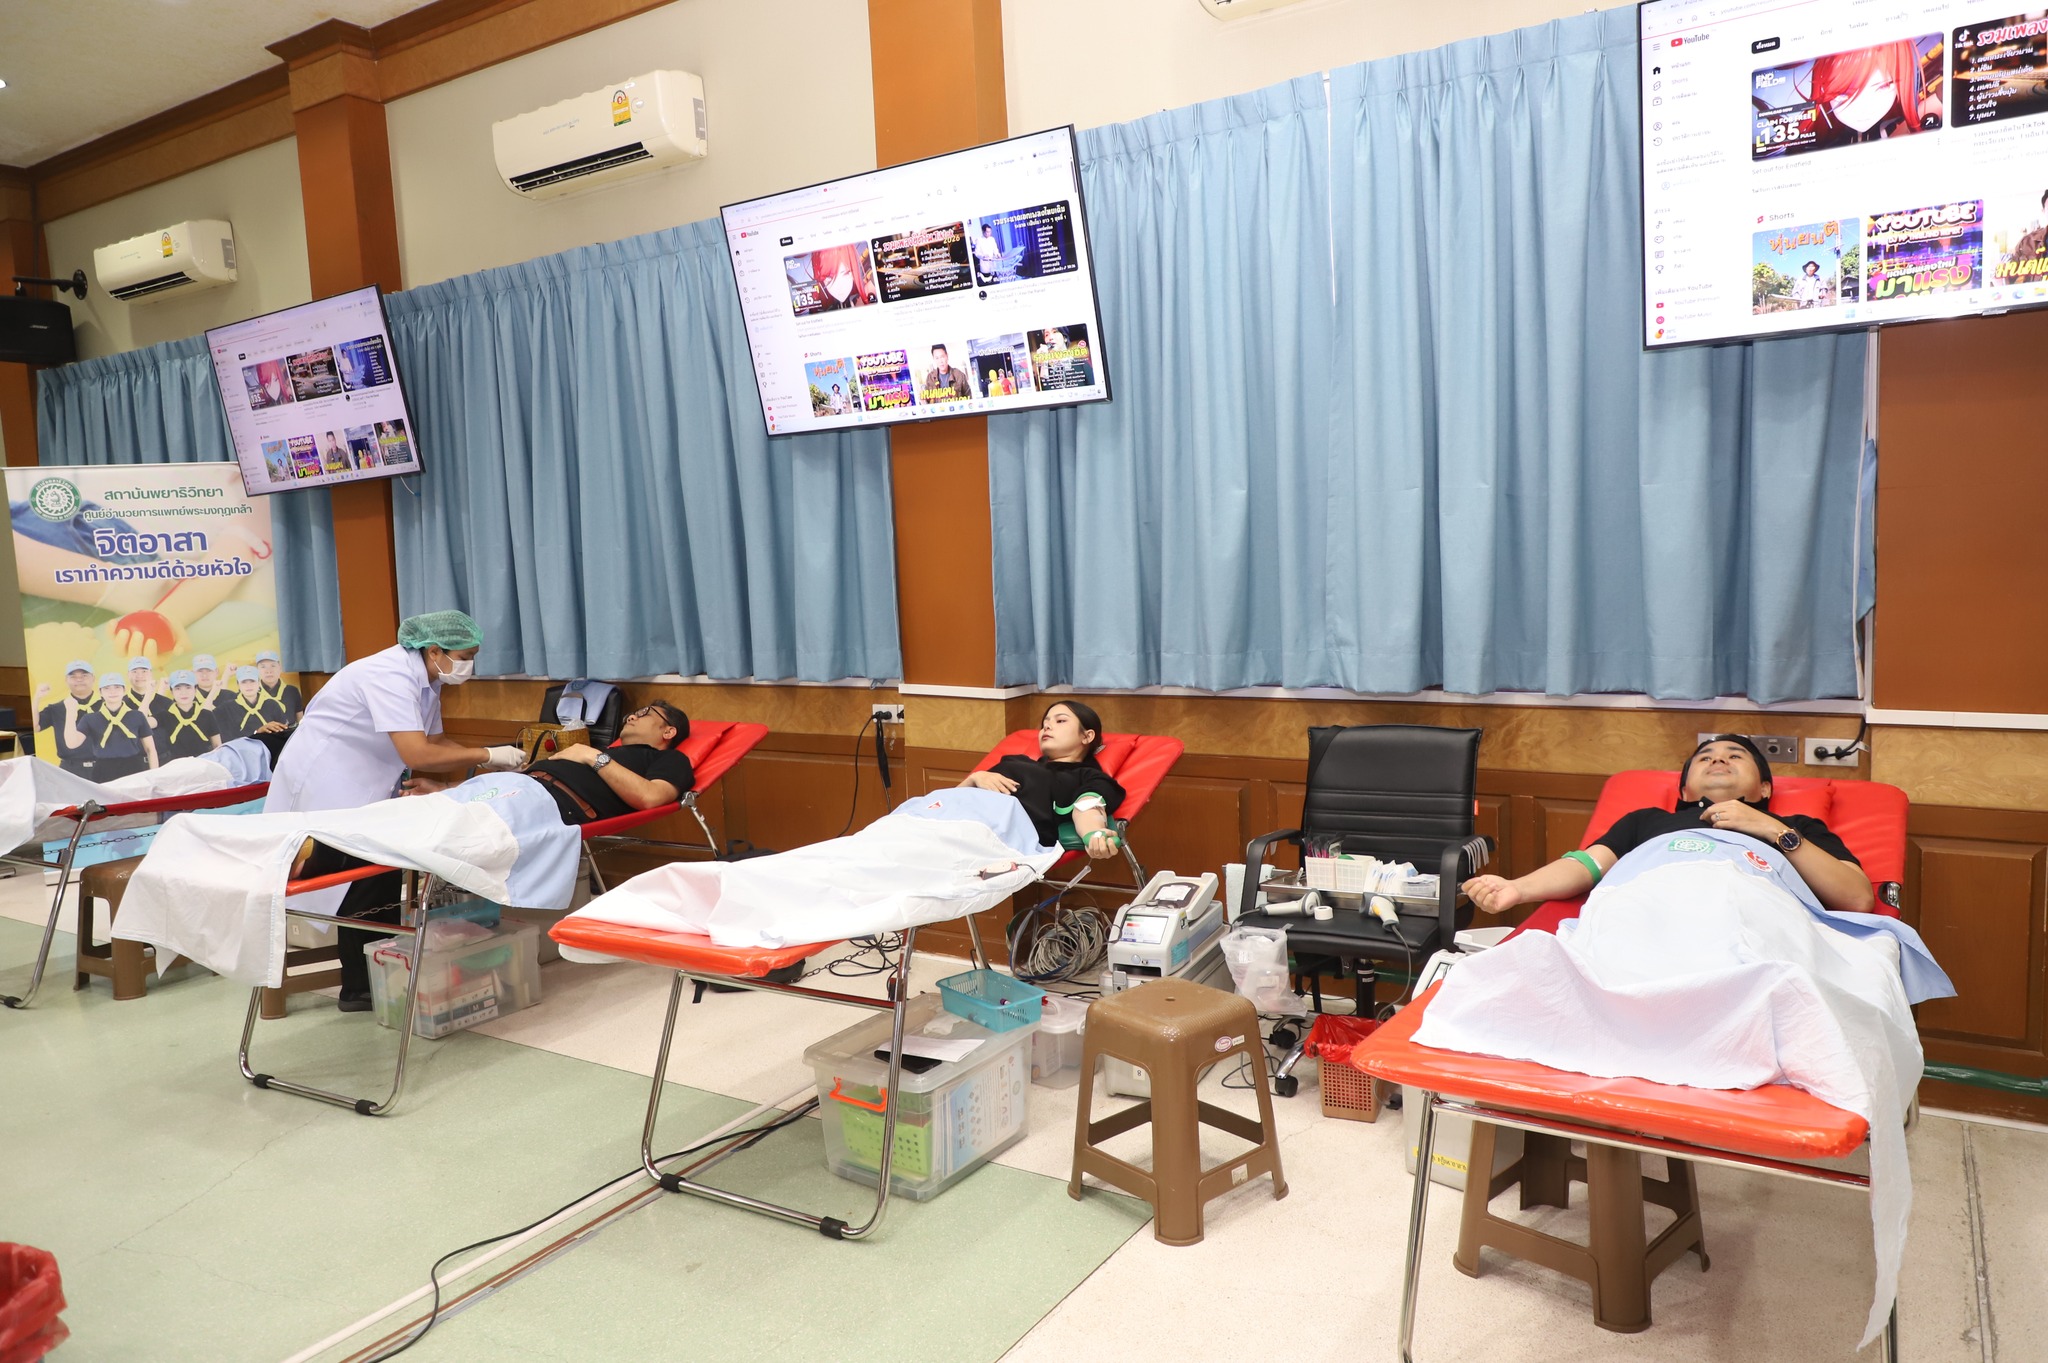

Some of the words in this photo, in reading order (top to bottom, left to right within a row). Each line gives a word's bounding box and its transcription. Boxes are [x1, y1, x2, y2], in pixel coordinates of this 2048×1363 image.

[1683, 33, 1710, 45] YouTube
[1756, 73, 1774, 83] END
[1756, 117, 1778, 128] CLAIM
[1779, 115, 1795, 124] FOR
[1795, 112, 1812, 121] FREE
[1760, 122, 1800, 145] 135
[1785, 159, 1812, 169] Endfield
[1768, 211, 1795, 221] Shorts
[1876, 203, 1977, 233] YOUTUBE
[943, 235, 961, 245] 2026
[1875, 264, 1973, 299] มาแรง
[795, 293, 813, 307] 135
[868, 391, 911, 410] มาแรง
[104, 486, 223, 501] สถาบันพยาธิวิทยา
[94, 529, 208, 556] จิตอาสา
[55, 557, 253, 584] เราทำความดีด้วยหัวใจ
